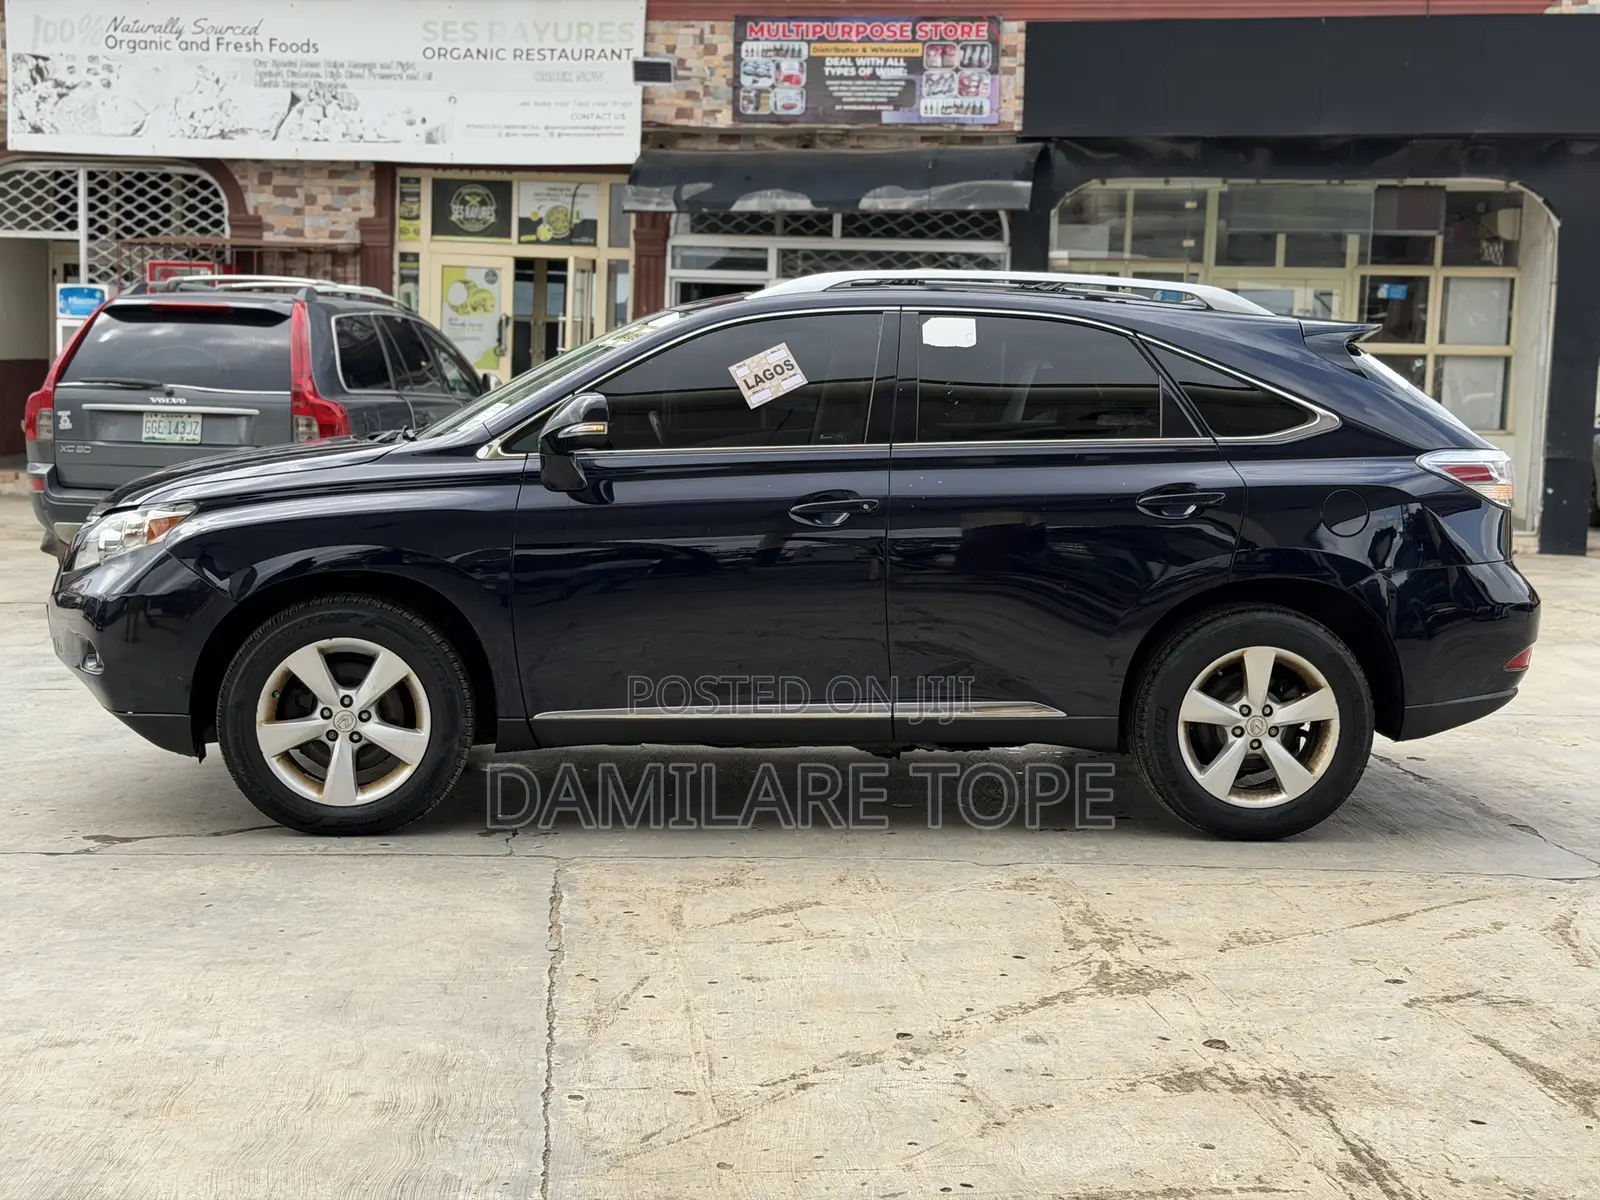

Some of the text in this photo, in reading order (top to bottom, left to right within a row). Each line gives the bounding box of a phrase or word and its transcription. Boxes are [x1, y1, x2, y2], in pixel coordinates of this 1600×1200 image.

[105, 16, 264, 39] Naturally Sourced
[421, 20, 636, 44] SES RAYURES
[747, 21, 989, 40] MULTIPURPOSE STORE
[104, 35, 320, 54] Organic and Fresh Foods
[422, 46, 634, 61] ORGANIC RESTAURANT
[824, 57, 907, 67] DEAL WITH ALL
[823, 67, 857, 76] TYPES
[858, 67, 873, 76] OF
[570, 112, 612, 121] CONTACT
[742, 359, 795, 391] LAGOS
[149, 396, 188, 405] VOLVO
